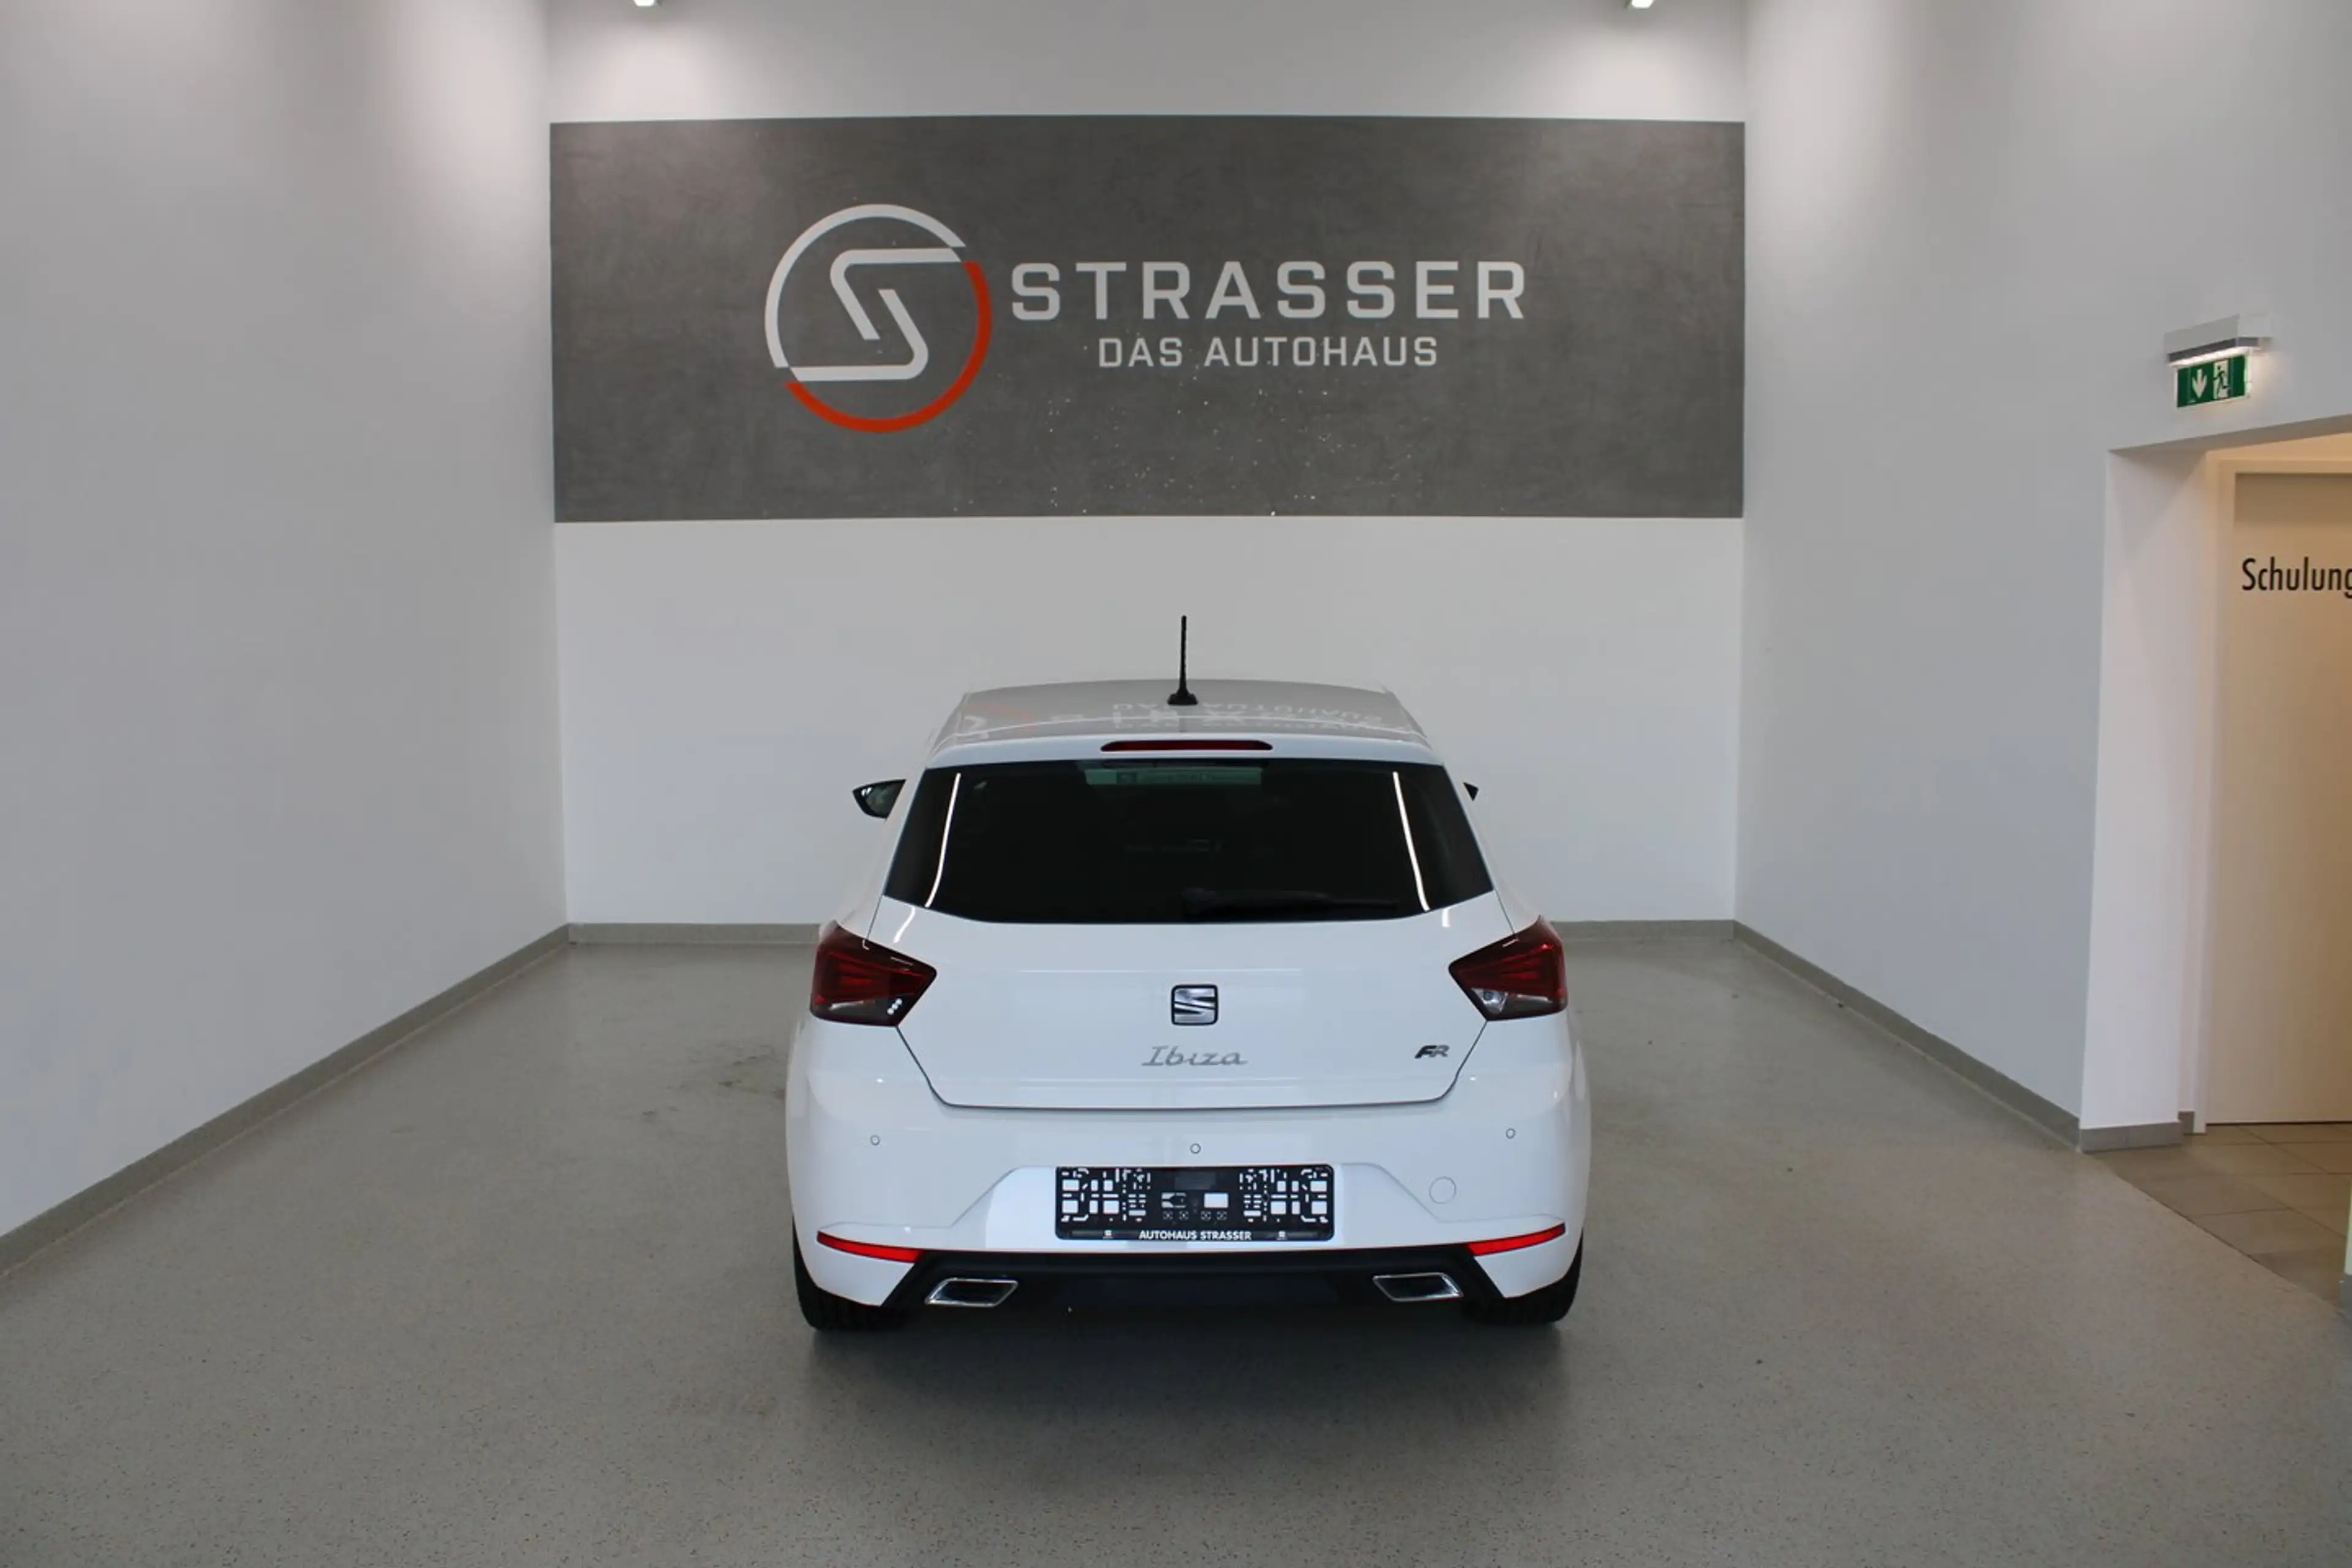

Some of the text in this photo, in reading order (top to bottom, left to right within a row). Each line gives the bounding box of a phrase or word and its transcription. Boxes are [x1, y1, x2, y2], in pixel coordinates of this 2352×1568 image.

[1011, 260, 1525, 320] STRASSER
[1098, 336, 1438, 368] DAS AUTOHAUS
[1141, 1046, 1248, 1066] Ibiza
[1414, 1044, 1450, 1059] FR
[1139, 1230, 1252, 1241] AUTOHAUS STRASSER
